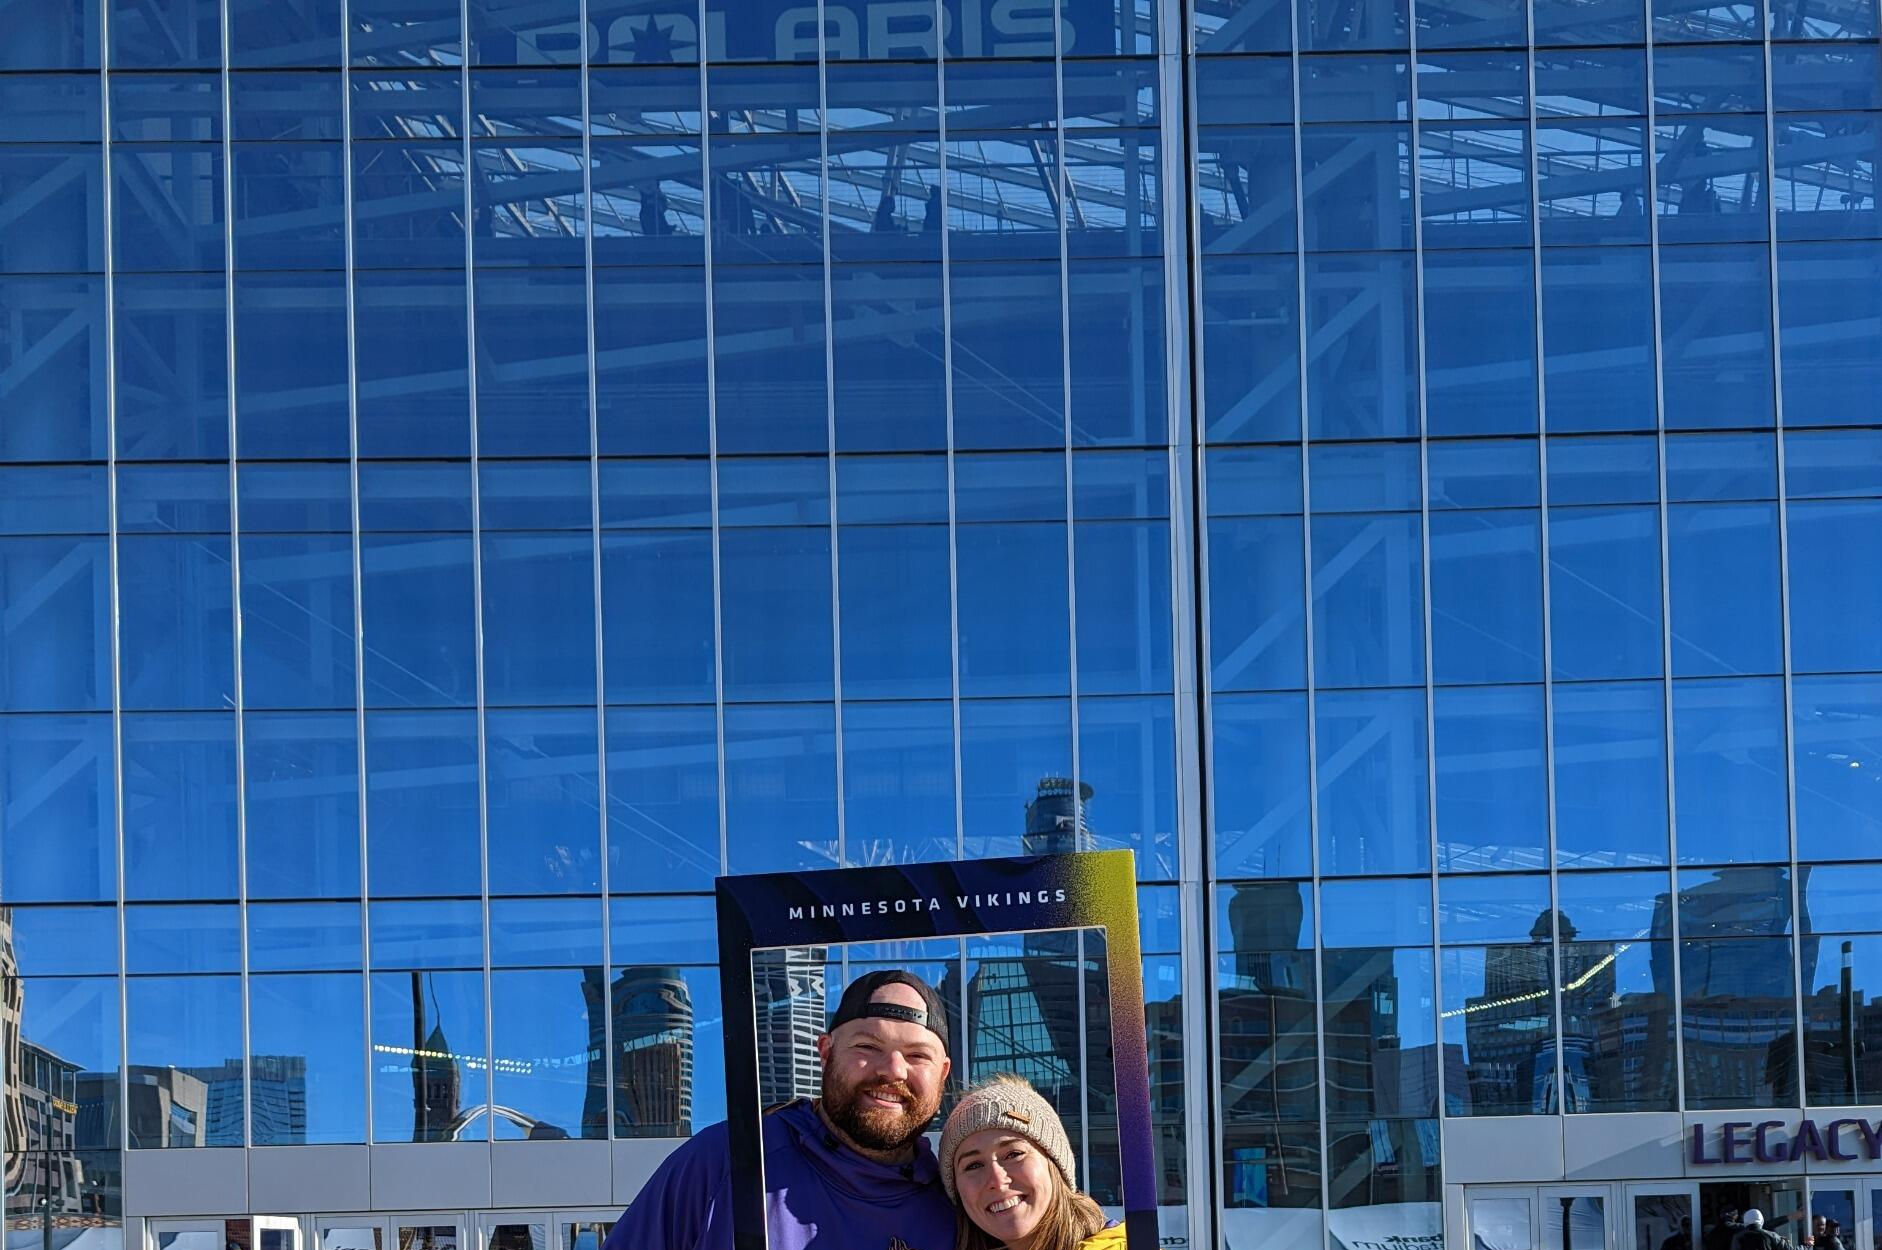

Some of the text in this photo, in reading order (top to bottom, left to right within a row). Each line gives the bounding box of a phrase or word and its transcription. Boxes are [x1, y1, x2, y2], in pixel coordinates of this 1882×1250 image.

[516, 0, 1076, 64] POLARIS
[789, 889, 1067, 920] MINNESOTA VIKINGS
[1694, 1119, 1882, 1164] LEGACY
